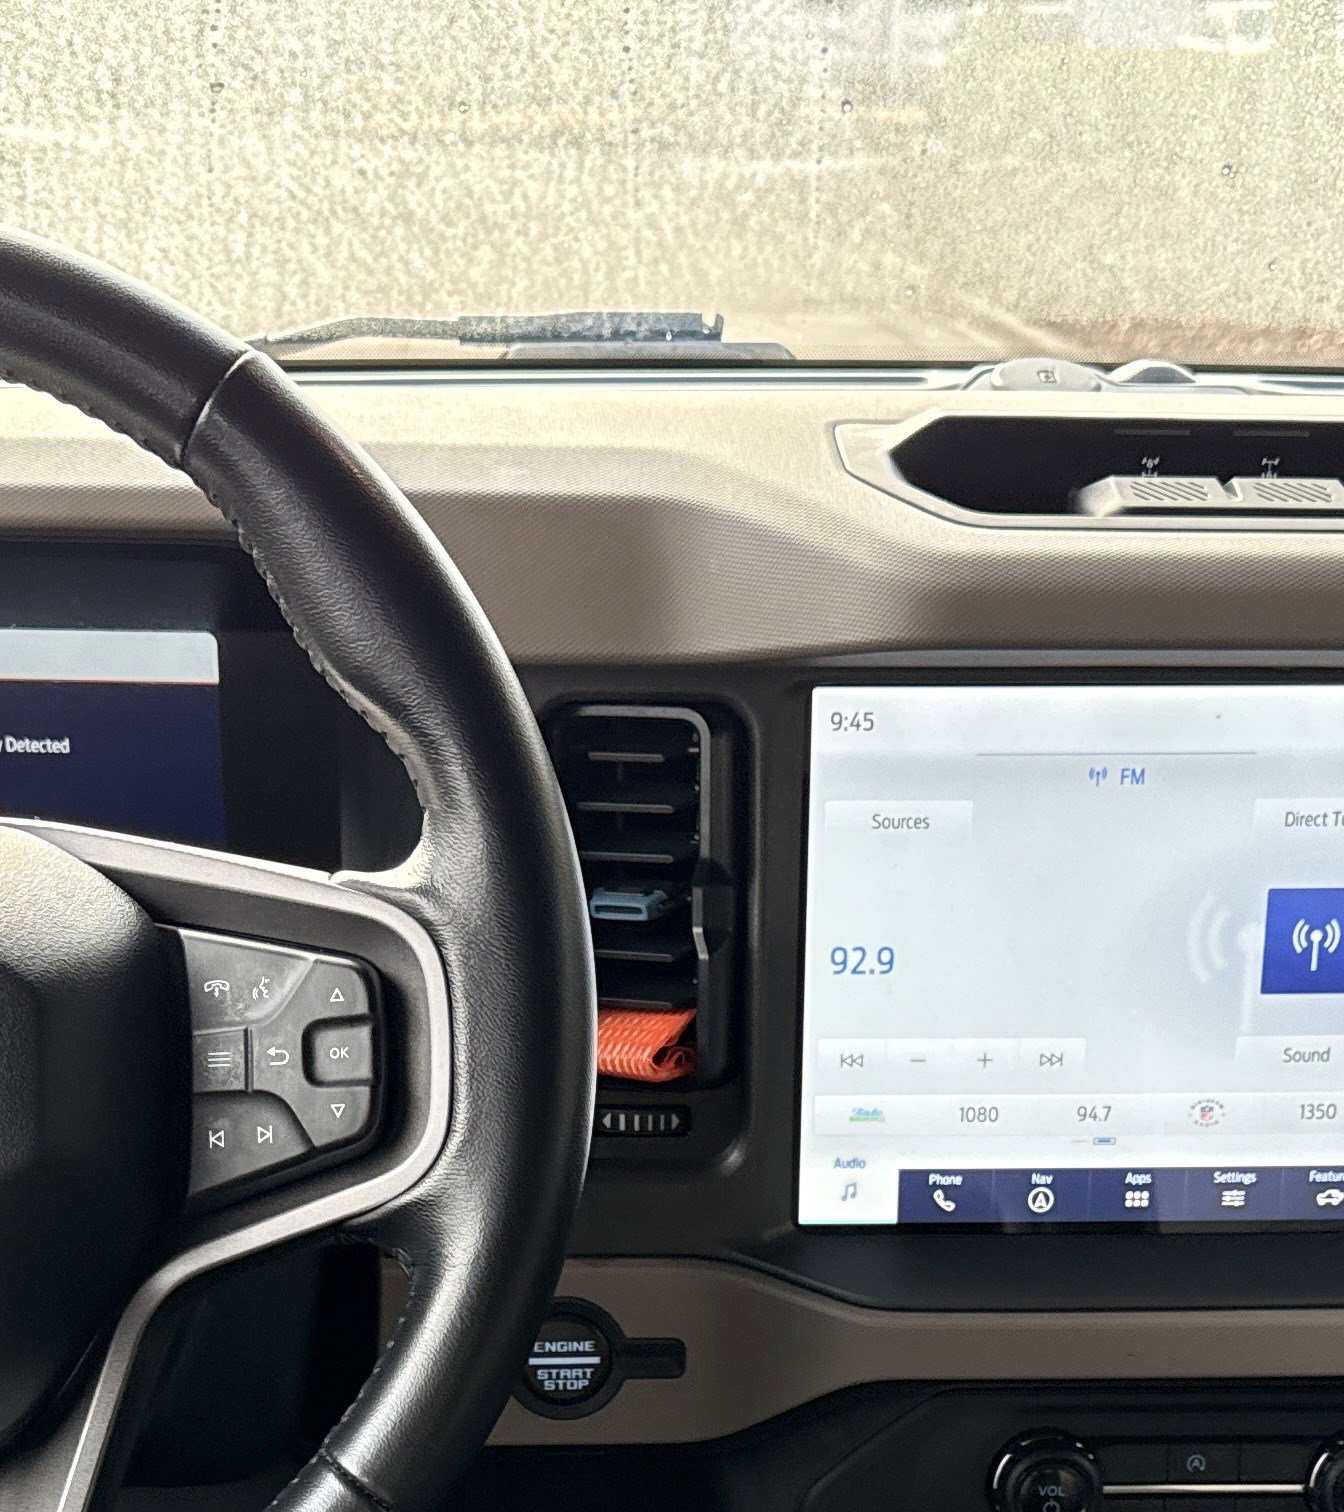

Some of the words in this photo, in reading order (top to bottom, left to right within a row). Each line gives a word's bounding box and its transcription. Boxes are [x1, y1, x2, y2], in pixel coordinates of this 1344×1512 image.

[830, 712, 875, 732] 9:45
[6, 737, 70, 753] Detected
[1120, 768, 1146, 785] FM
[871, 814, 930, 830] Sources
[1284, 811, 1327, 827] Direct
[830, 946, 895, 975] 92.9
[329, 1046, 350, 1060] OK
[1283, 1047, 1331, 1063] Sound
[959, 1106, 999, 1123] 1080
[1077, 1105, 1112, 1122] 94.7
[1299, 1103, 1337, 1120] 1350
[834, 1156, 866, 1170] Audio
[929, 1172, 962, 1187] Phone
[1031, 1172, 1053, 1185] Nav
[1125, 1171, 1152, 1187] Apps
[1213, 1170, 1257, 1187] Settings
[533, 1340, 596, 1353] ENGINE
[536, 1368, 594, 1380] START
[543, 1379, 590, 1391] STOP
[1038, 1485, 1065, 1497] VOL
